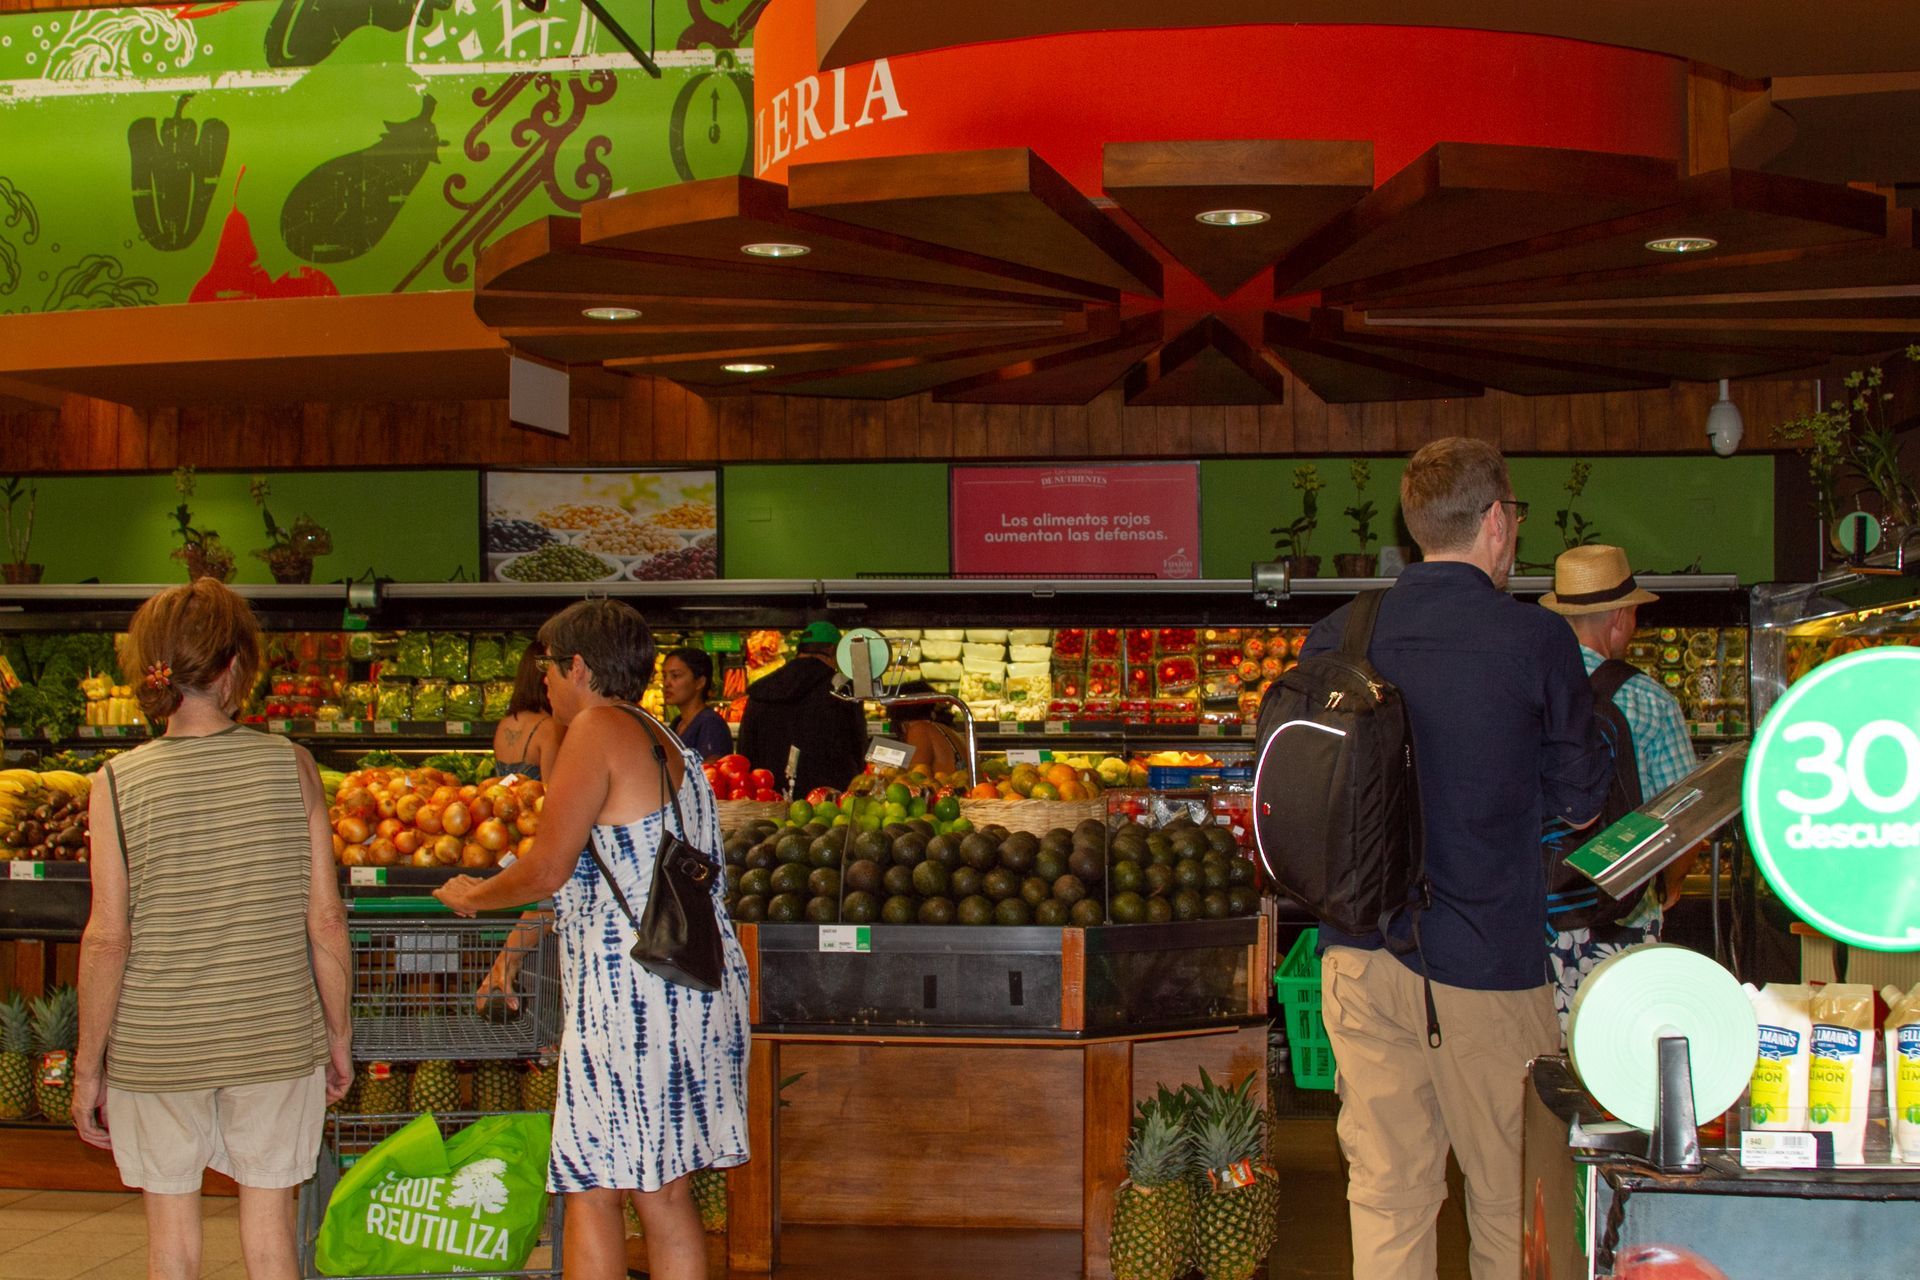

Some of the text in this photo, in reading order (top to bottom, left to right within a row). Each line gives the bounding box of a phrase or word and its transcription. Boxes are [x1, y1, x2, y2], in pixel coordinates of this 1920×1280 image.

[1053, 475, 1108, 485] NUTRIENTES
[1001, 512, 1151, 529] Los alimentos rojos
[984, 527, 1168, 543] aumentan las defensas.
[1776, 719, 1920, 815] 30
[366, 1203, 509, 1262] REUTILIZA
